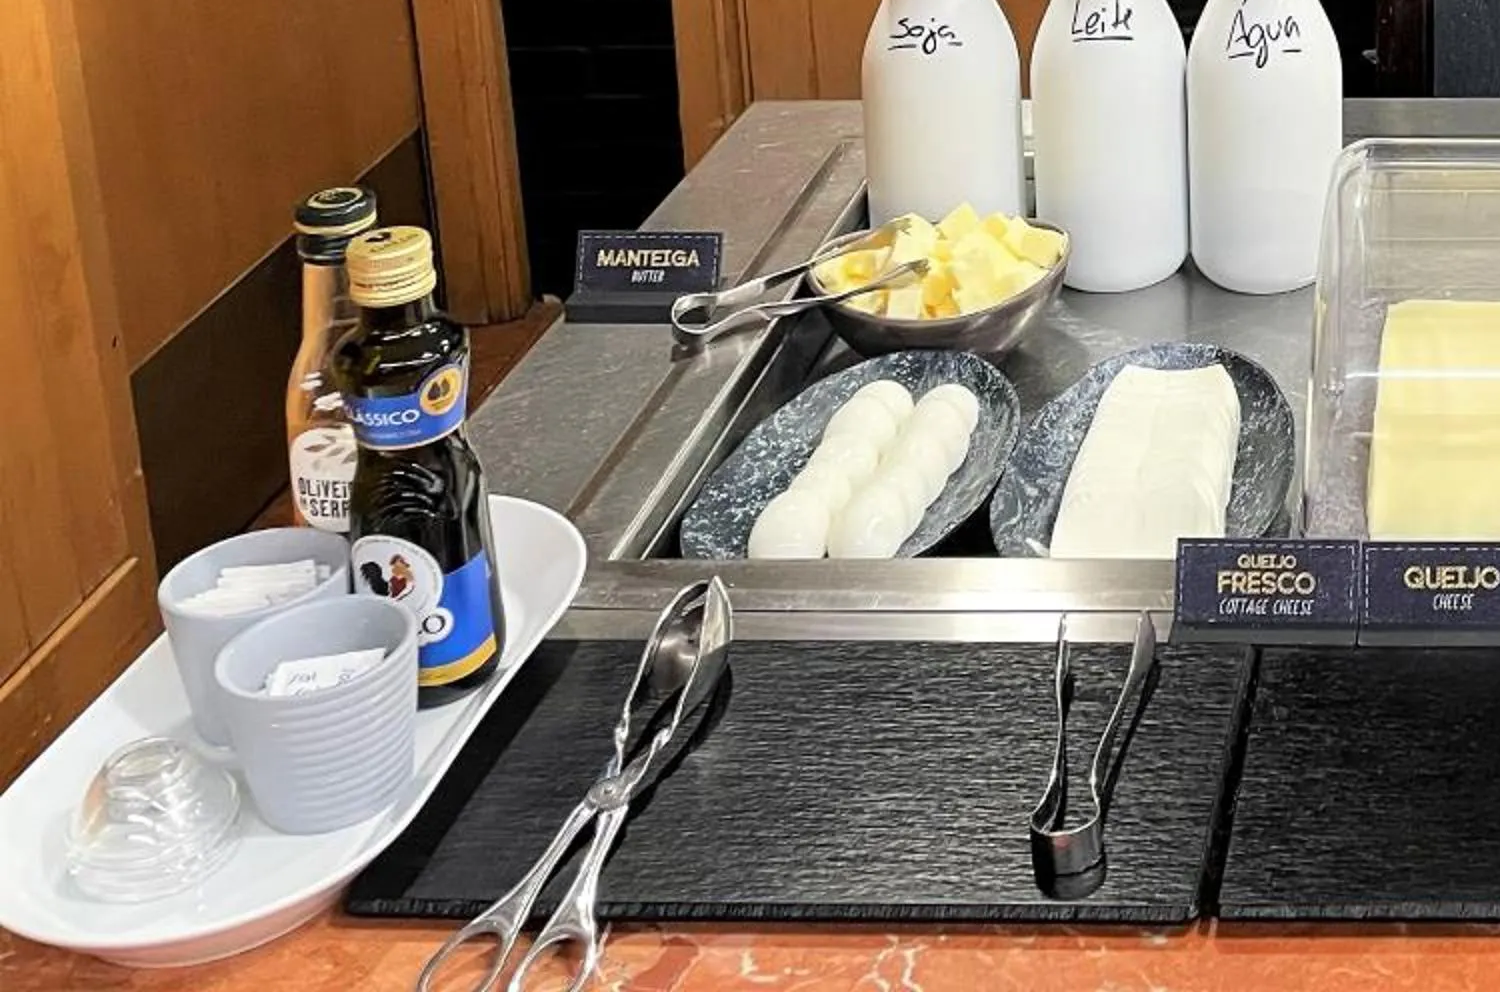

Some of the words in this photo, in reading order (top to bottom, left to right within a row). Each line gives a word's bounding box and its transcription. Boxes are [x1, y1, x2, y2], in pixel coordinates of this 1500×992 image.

[596, 249, 700, 267] MANTEIGA
[631, 269, 665, 283] BUTTER
[1237, 554, 1297, 569] QUEIJO
[1217, 571, 1316, 595] FRESCO
[1404, 566, 1500, 589] QUEIJO
[1219, 598, 1269, 615] COTTAGE
[1273, 598, 1315, 615] CHEESE
[1433, 594, 1474, 610] CHEESE
